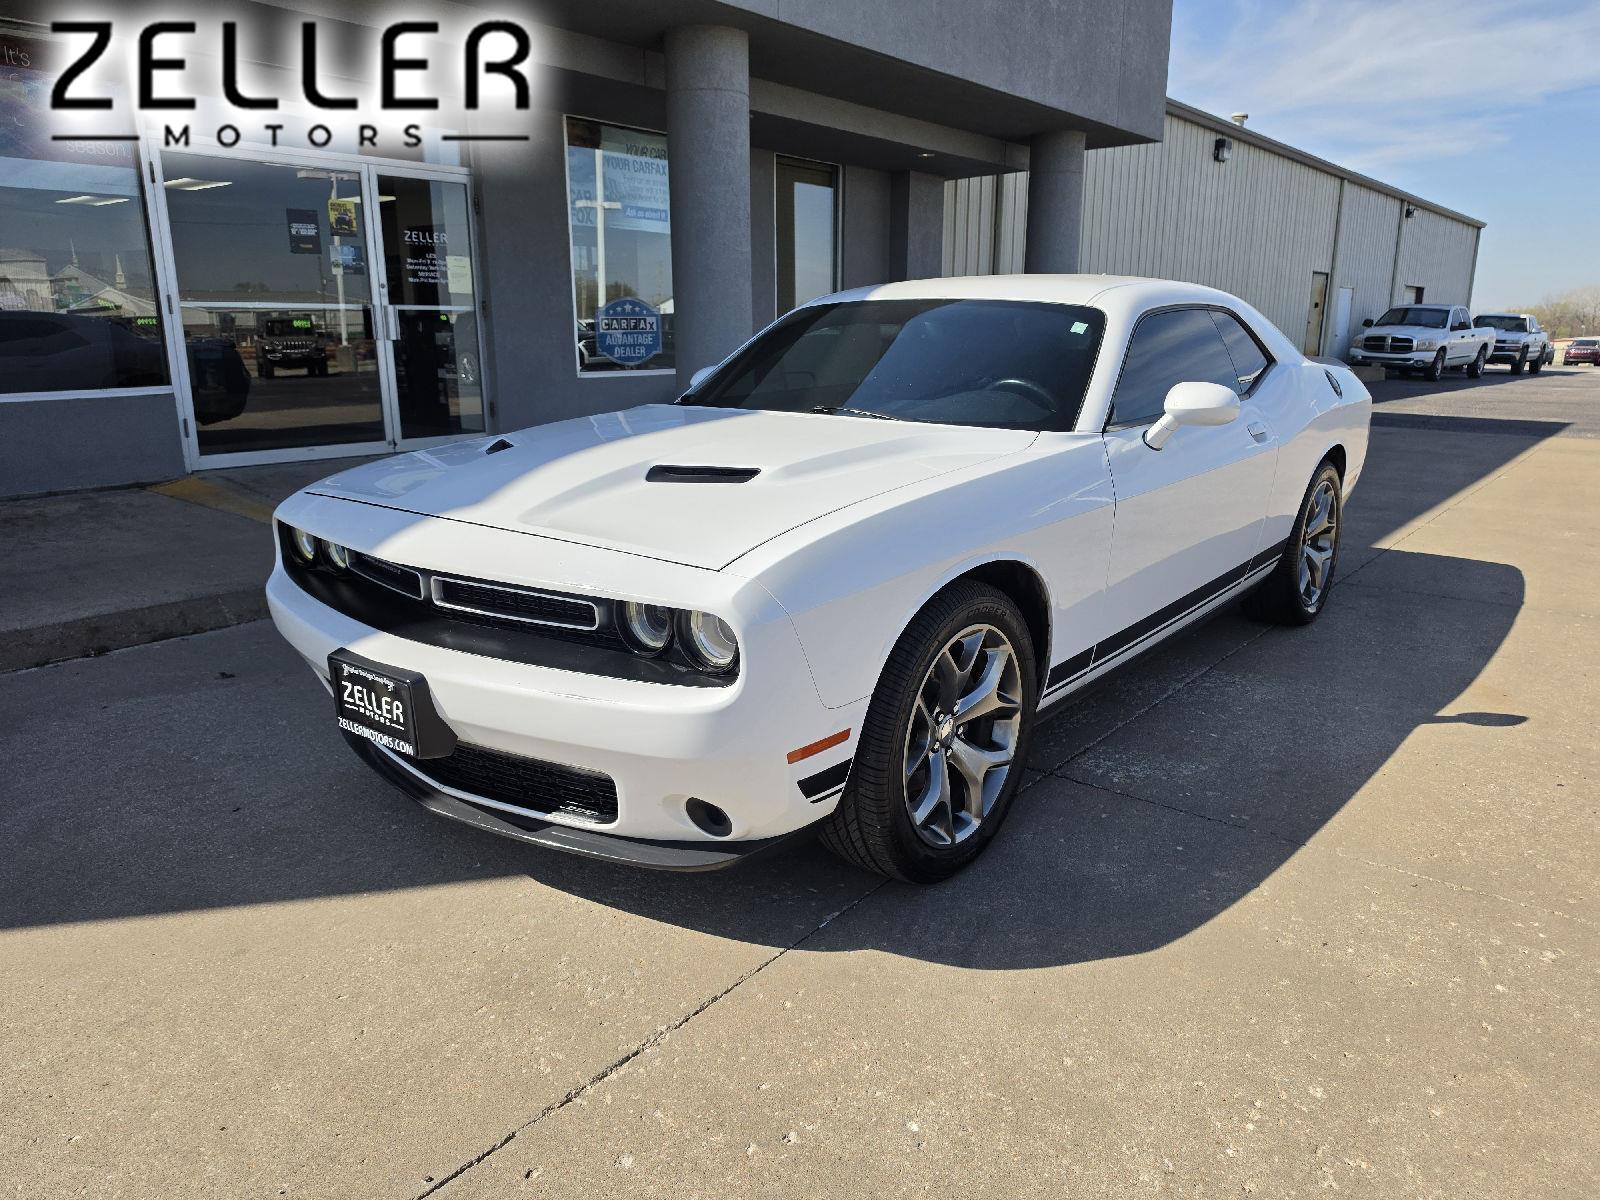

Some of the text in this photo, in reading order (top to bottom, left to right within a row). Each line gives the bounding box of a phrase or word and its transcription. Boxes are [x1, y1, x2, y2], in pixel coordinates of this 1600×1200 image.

[3, 46, 31, 67] It's
[404, 230, 449, 244] ZELLER
[601, 318, 655, 331] CARFAX
[606, 333, 654, 345] ADVANTAGE
[614, 346, 646, 357] DEALER
[341, 680, 404, 723] ZELLER
[359, 706, 391, 726] MOTORS
[338, 716, 414, 756] ZELLERMOTORS.COM
